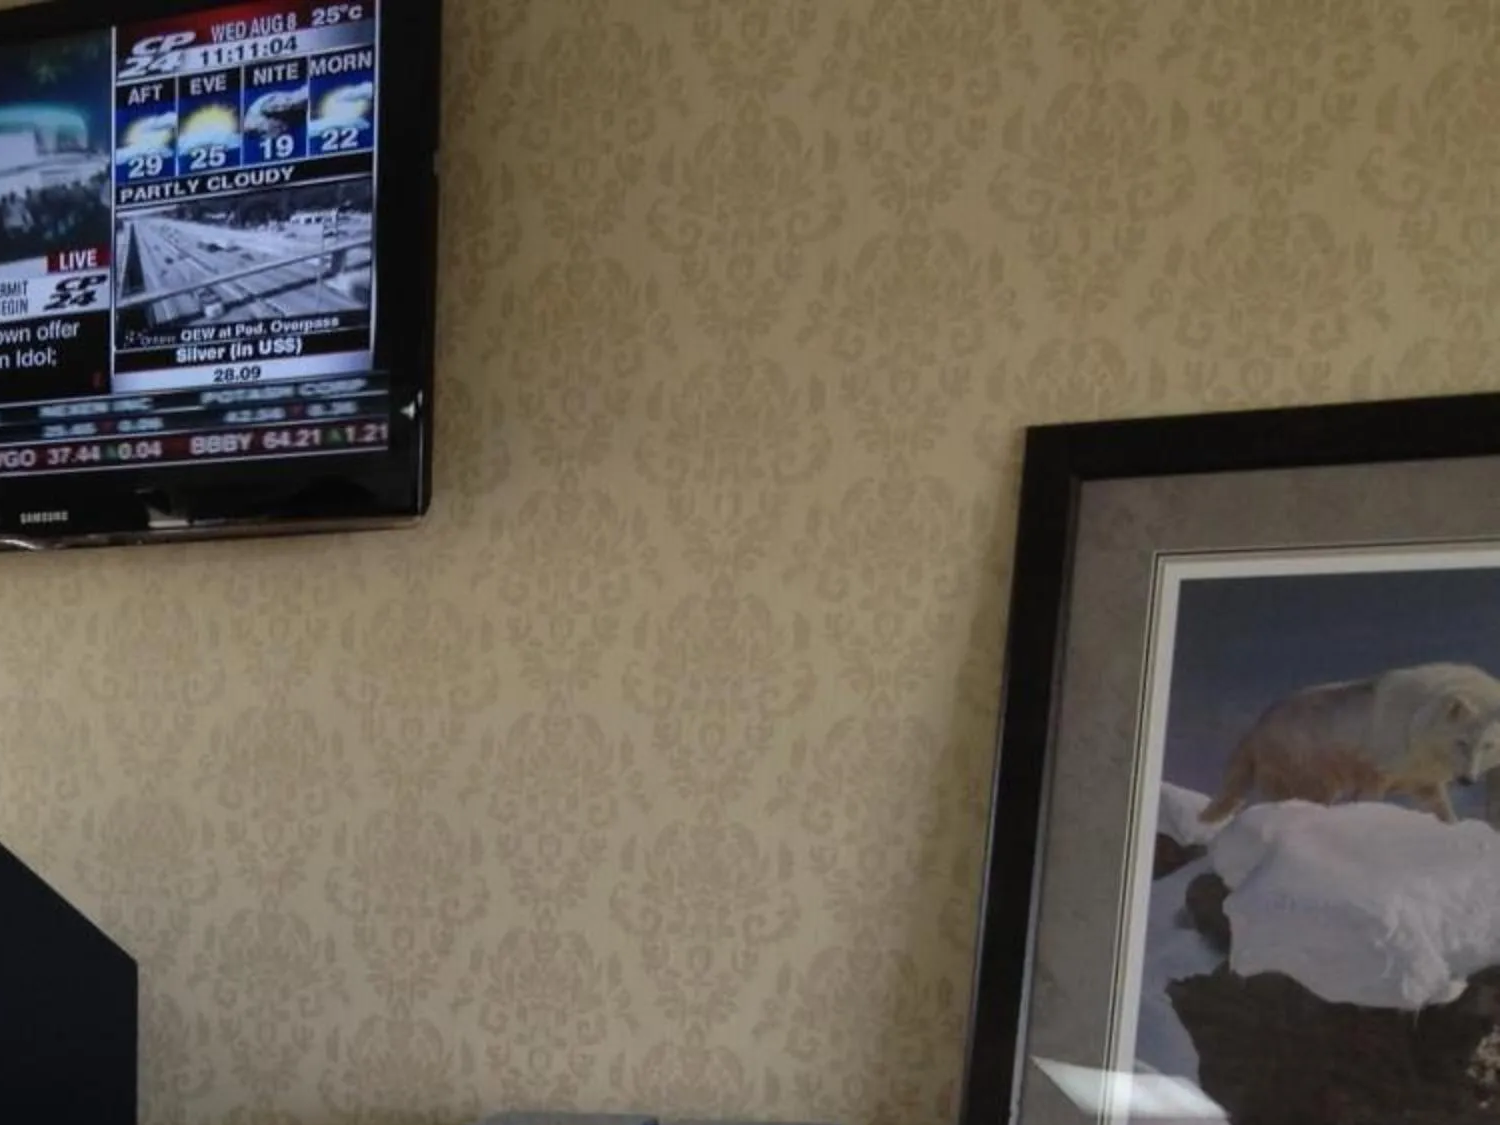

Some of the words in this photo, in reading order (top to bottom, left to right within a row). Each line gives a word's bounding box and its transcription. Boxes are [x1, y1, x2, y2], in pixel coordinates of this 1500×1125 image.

[211, 22, 246, 43] WED
[251, 15, 283, 36] AUG
[132, 31, 196, 55] CP
[202, 36, 298, 66] 11:11:04
[118, 52, 181, 78] 24
[128, 84, 163, 106] AFT
[190, 74, 227, 95] EVE
[253, 62, 299, 86] NITE
[309, 51, 373, 77] MORN
[127, 153, 163, 179] 29
[190, 147, 226, 171] 25
[260, 134, 294, 160] 19
[321, 127, 359, 151] 22
[120, 180, 199, 203] PARTLY
[207, 166, 295, 192] CLOUDY
[59, 248, 98, 271] LIVE
[36, 320, 80, 341] offer
[180, 325, 216, 343] QEW
[219, 323, 233, 339] at
[235, 320, 268, 338] Ped.
[271, 316, 341, 335] Overpass
[176, 344, 226, 364] Silver
[230, 340, 254, 361] (in
[213, 365, 262, 383] 28.09
[47, 445, 101, 465] 37.44
[118, 441, 162, 460] 0.04
[189, 432, 252, 456] BBBY
[262, 429, 323, 450] 64.21
[344, 423, 389, 443] 1.21
[19, 510, 69, 525] SAMSUNG
